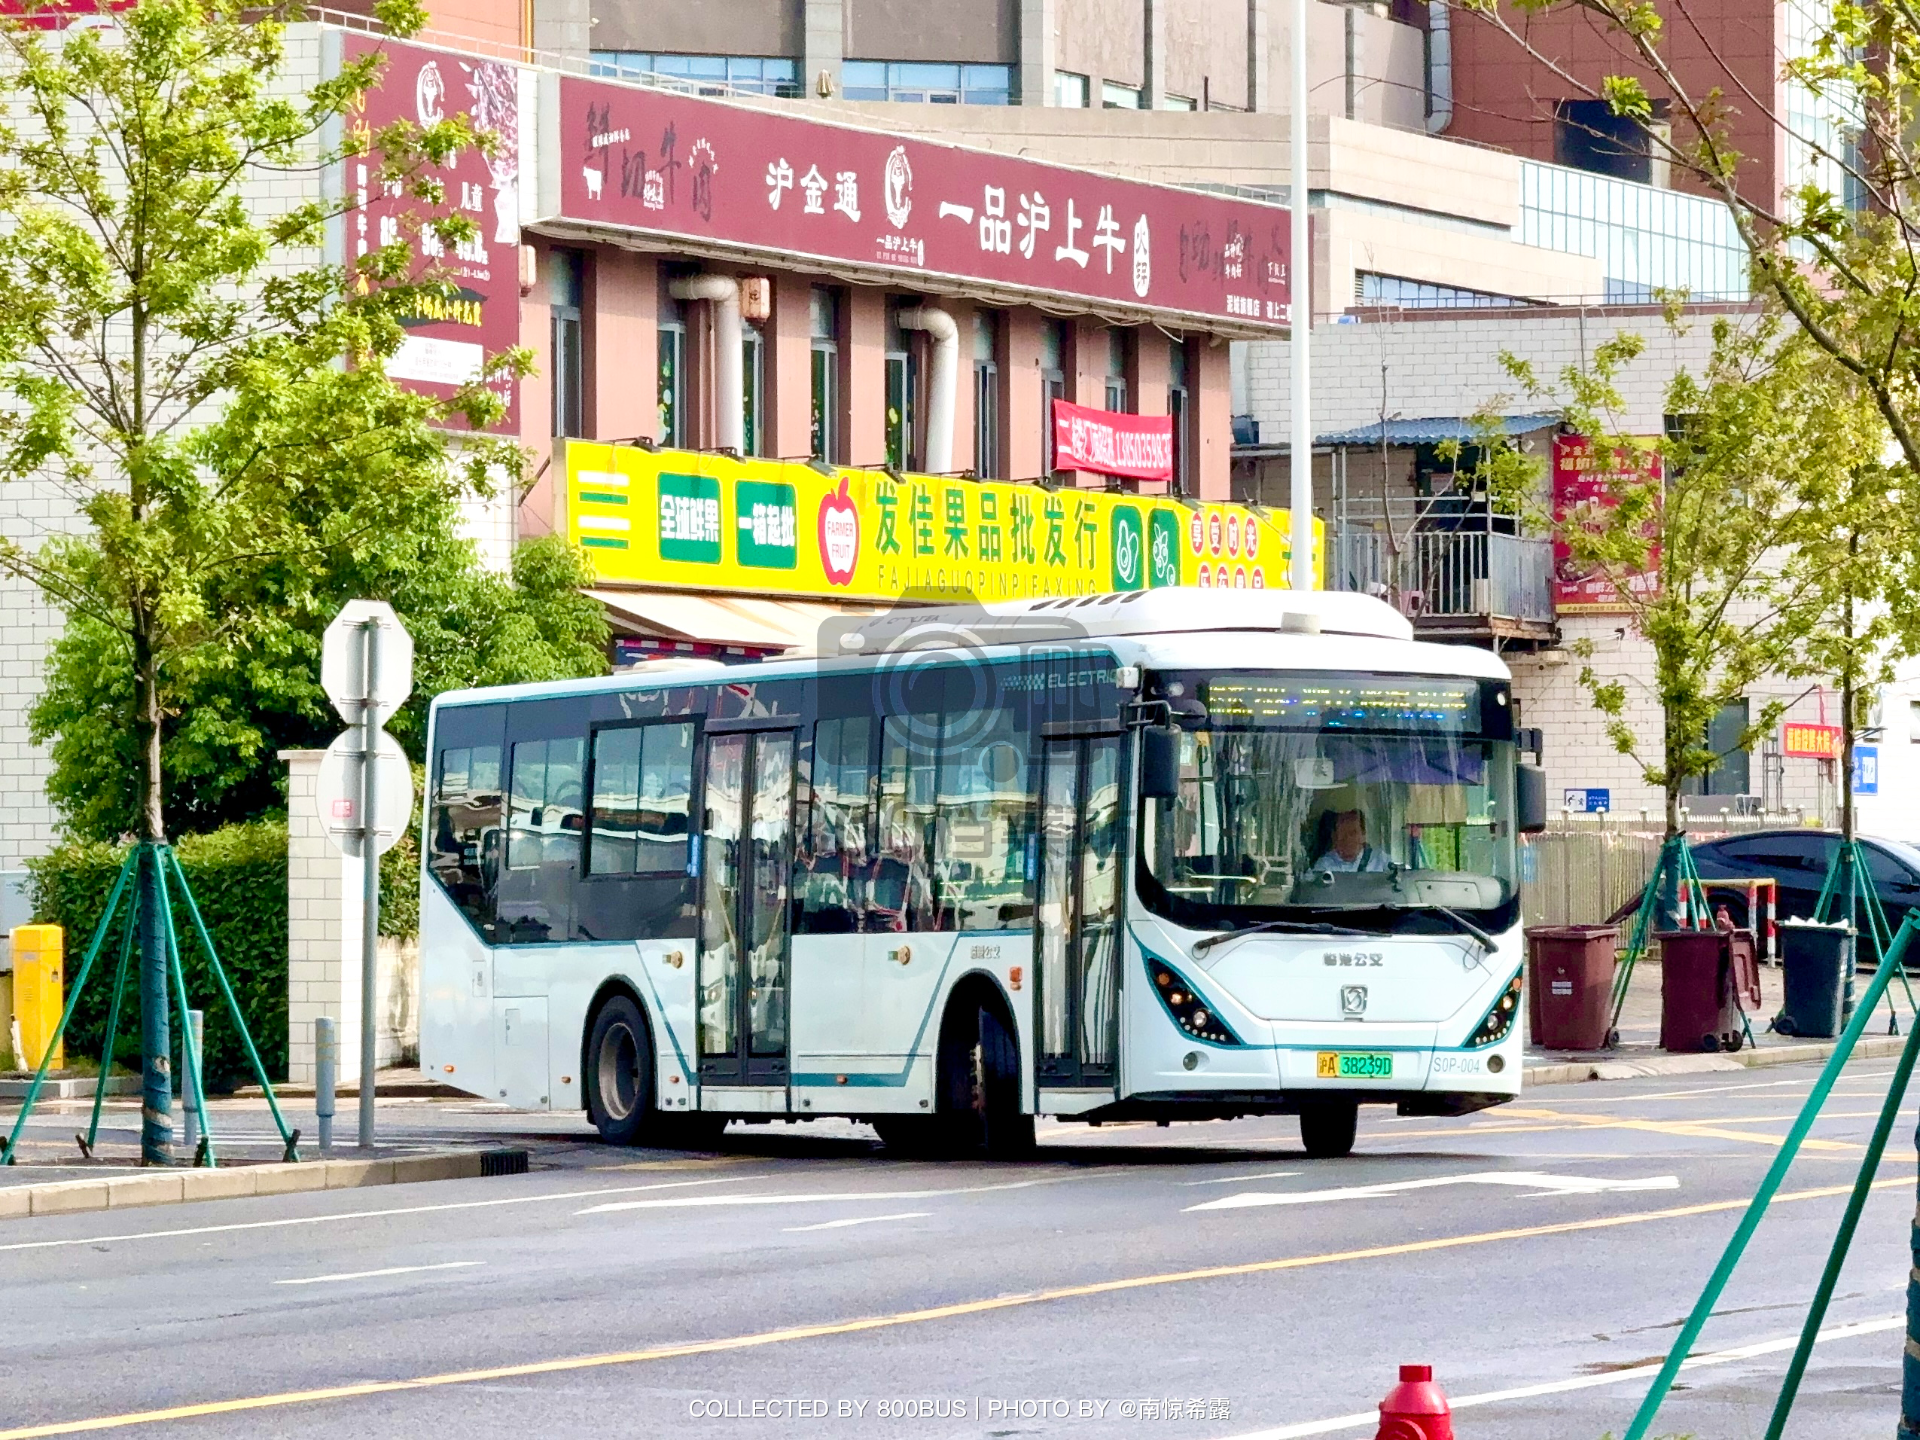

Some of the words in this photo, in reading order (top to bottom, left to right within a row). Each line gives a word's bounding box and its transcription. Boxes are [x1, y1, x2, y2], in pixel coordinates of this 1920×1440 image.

[460, 181, 483, 212] 儿童
[766, 157, 861, 223] 沪金通
[876, 234, 918, 254] 一品沪上牛
[939, 184, 1127, 275] 一品沪上牛
[660, 494, 719, 543] 全球鲜果
[738, 502, 796, 547] 一箱起批
[827, 520, 854, 538] FARMER
[876, 481, 1098, 571] 发佳果品批发行
[1192, 518, 1257, 552] 享受时光
[831, 543, 850, 560] FRUIT
[878, 564, 1097, 597] FAJIAGUOPINPIFAXING
[1319, 1057, 1336, 1075] 沪A
[1342, 1056, 1392, 1076] 38239D
